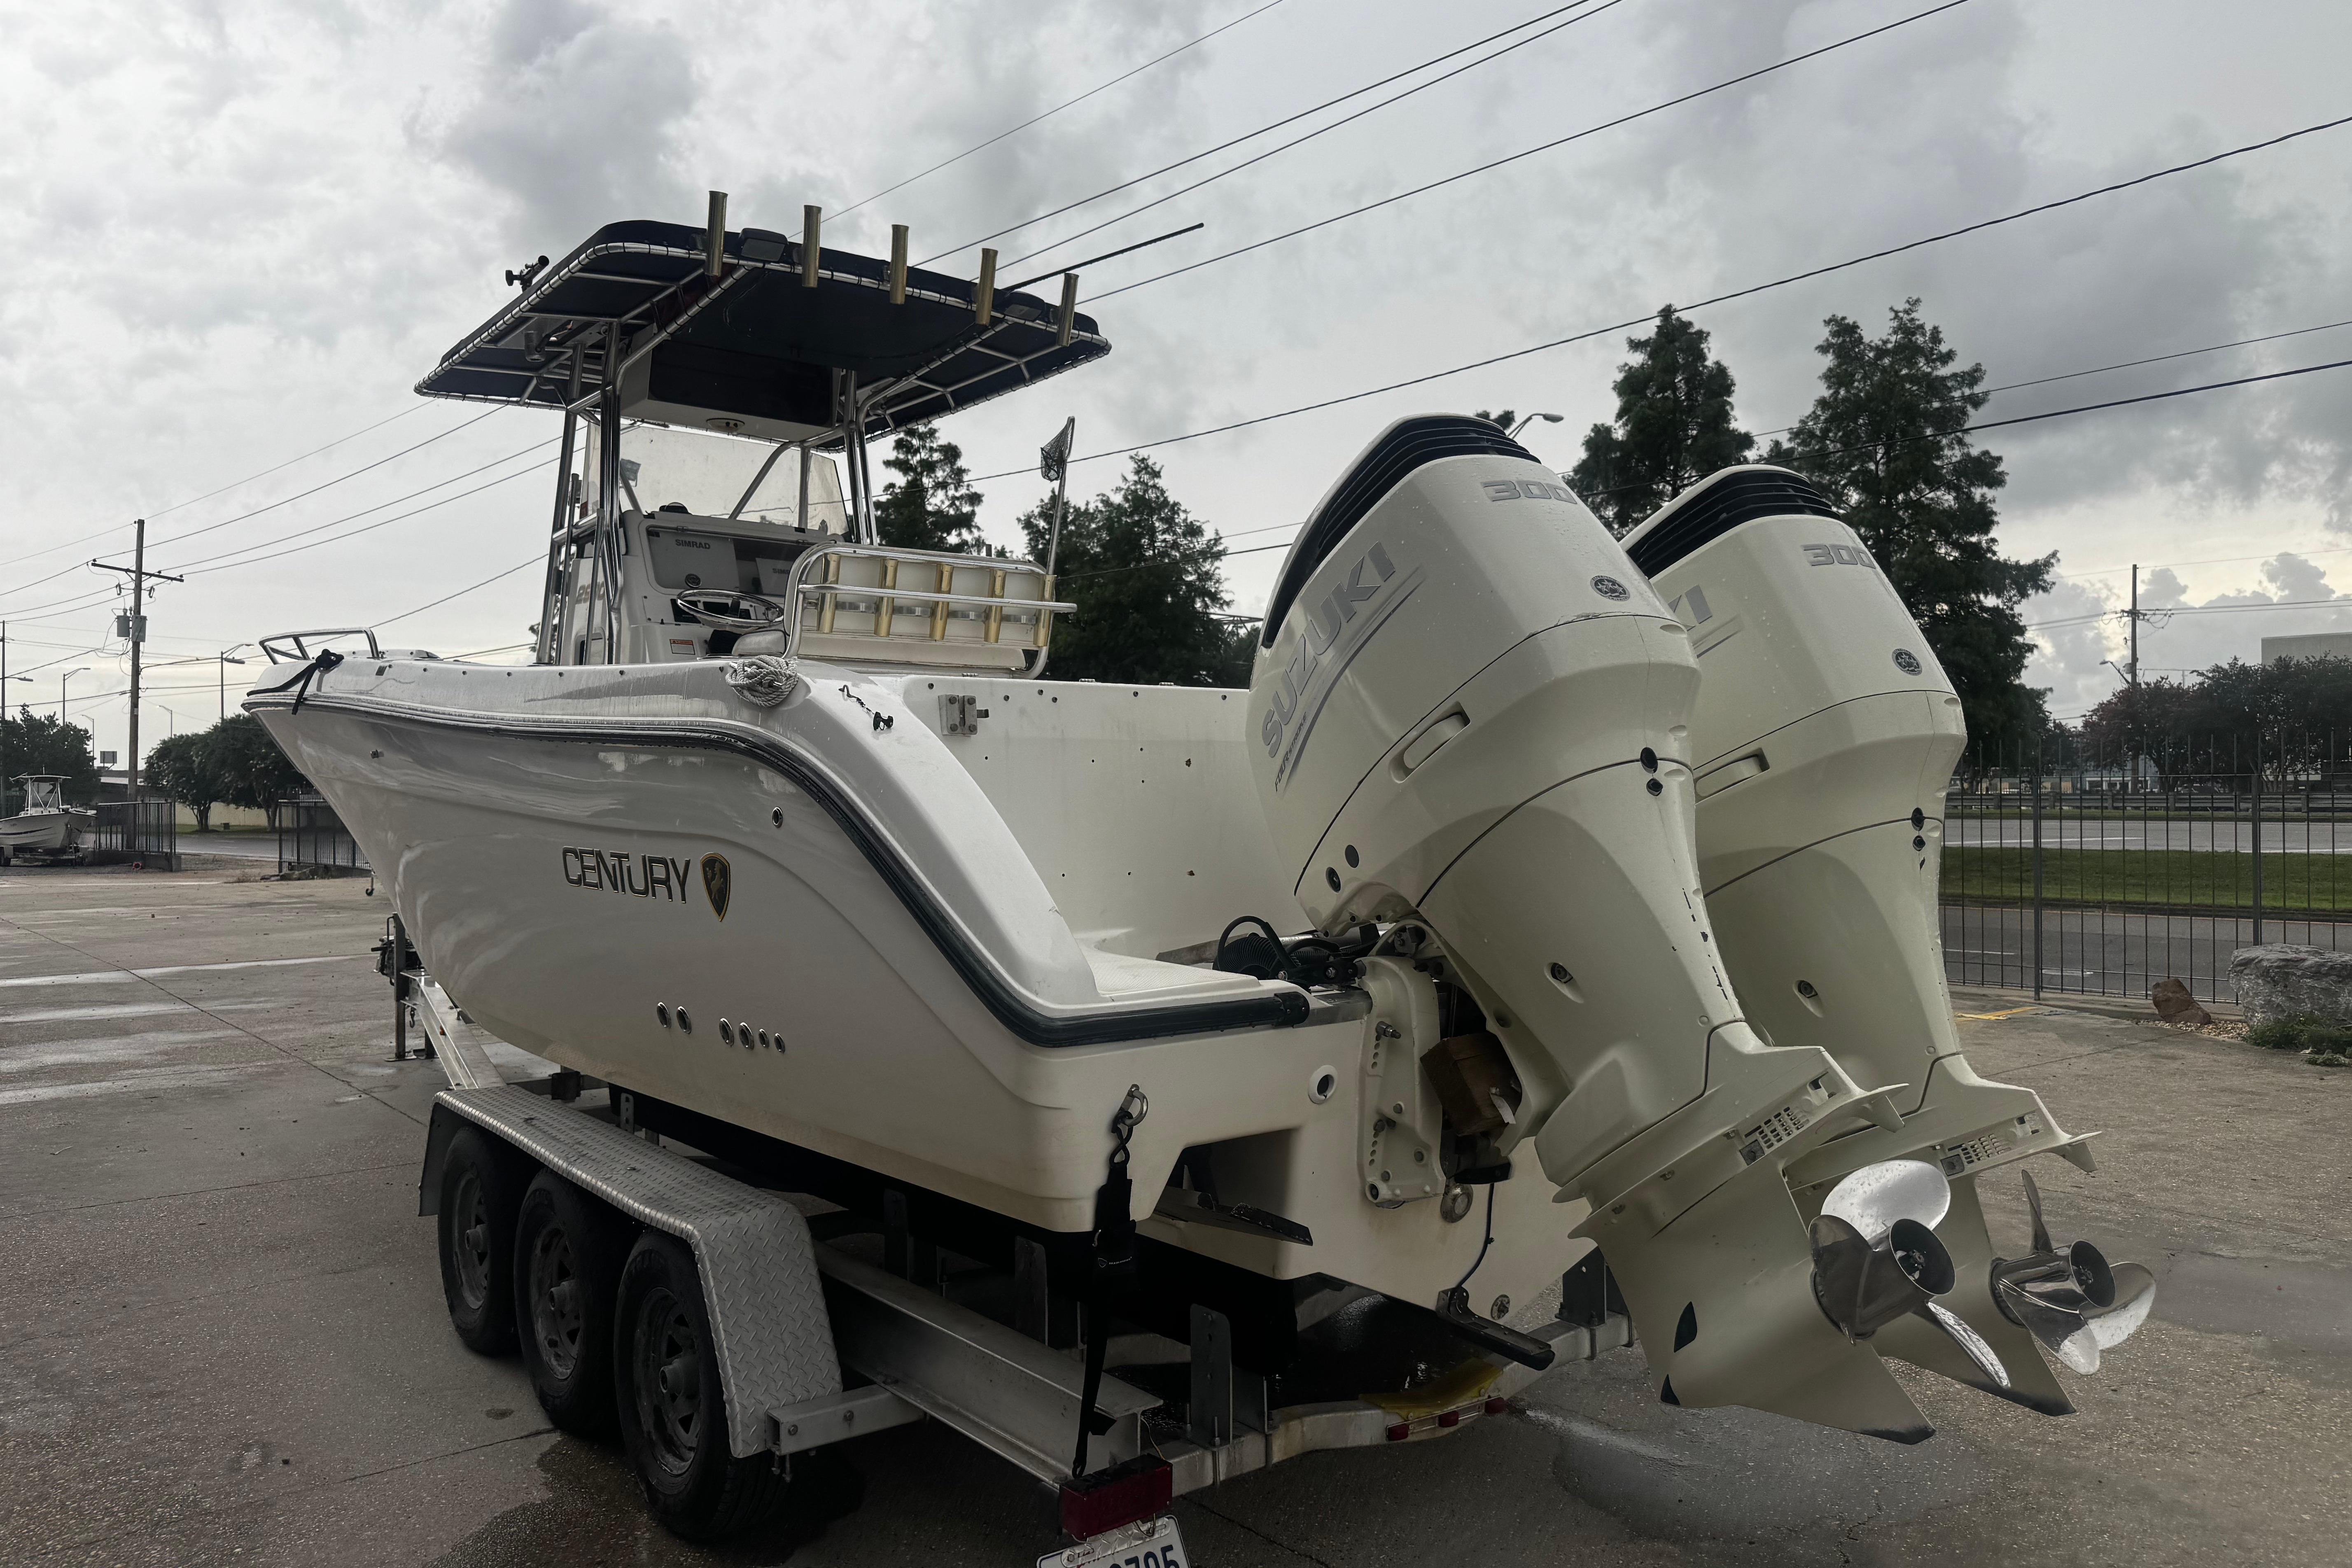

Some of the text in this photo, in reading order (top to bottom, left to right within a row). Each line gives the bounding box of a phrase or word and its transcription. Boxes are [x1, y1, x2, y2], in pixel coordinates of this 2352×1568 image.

[1482, 479, 1577, 504] 300
[675, 539, 710, 549] SIMRAD
[1800, 544, 1876, 569] 300
[1262, 541, 1396, 758] SUZUKI
[562, 846, 691, 903] CENTURY
